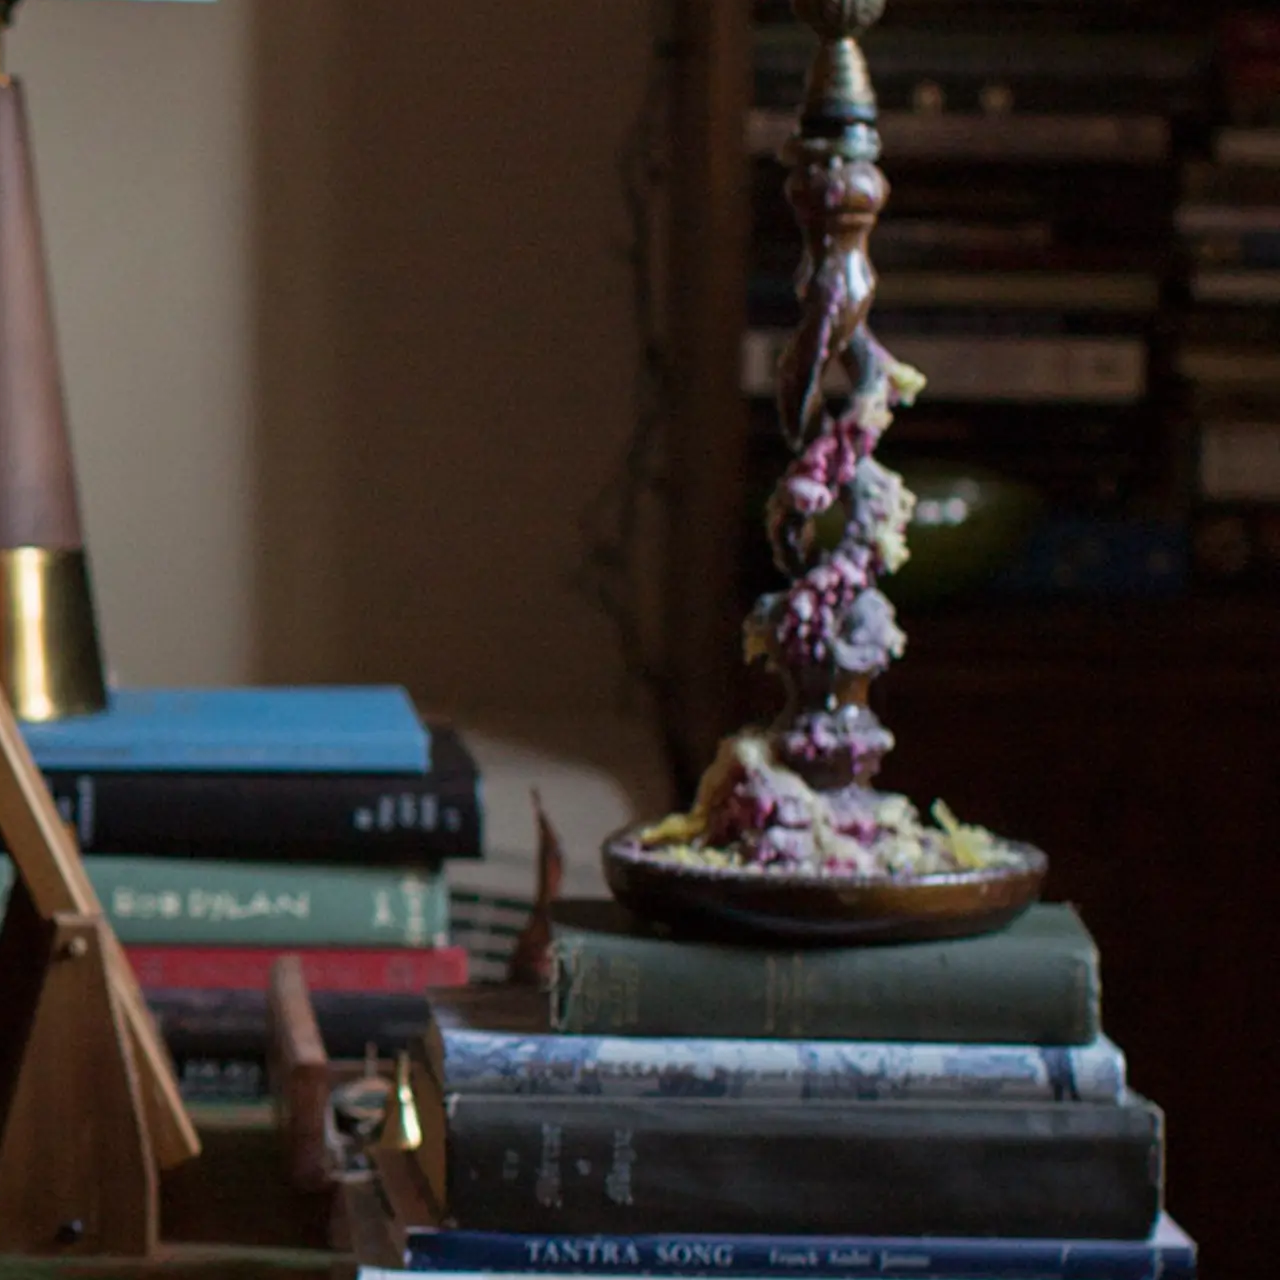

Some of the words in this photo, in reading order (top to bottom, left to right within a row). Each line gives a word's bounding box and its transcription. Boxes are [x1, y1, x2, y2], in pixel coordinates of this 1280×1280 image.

[112, 885, 181, 918] BOB
[187, 887, 310, 920] DYLAN
[524, 1239, 639, 1265] TANTRA
[655, 1241, 734, 1267] SONG
